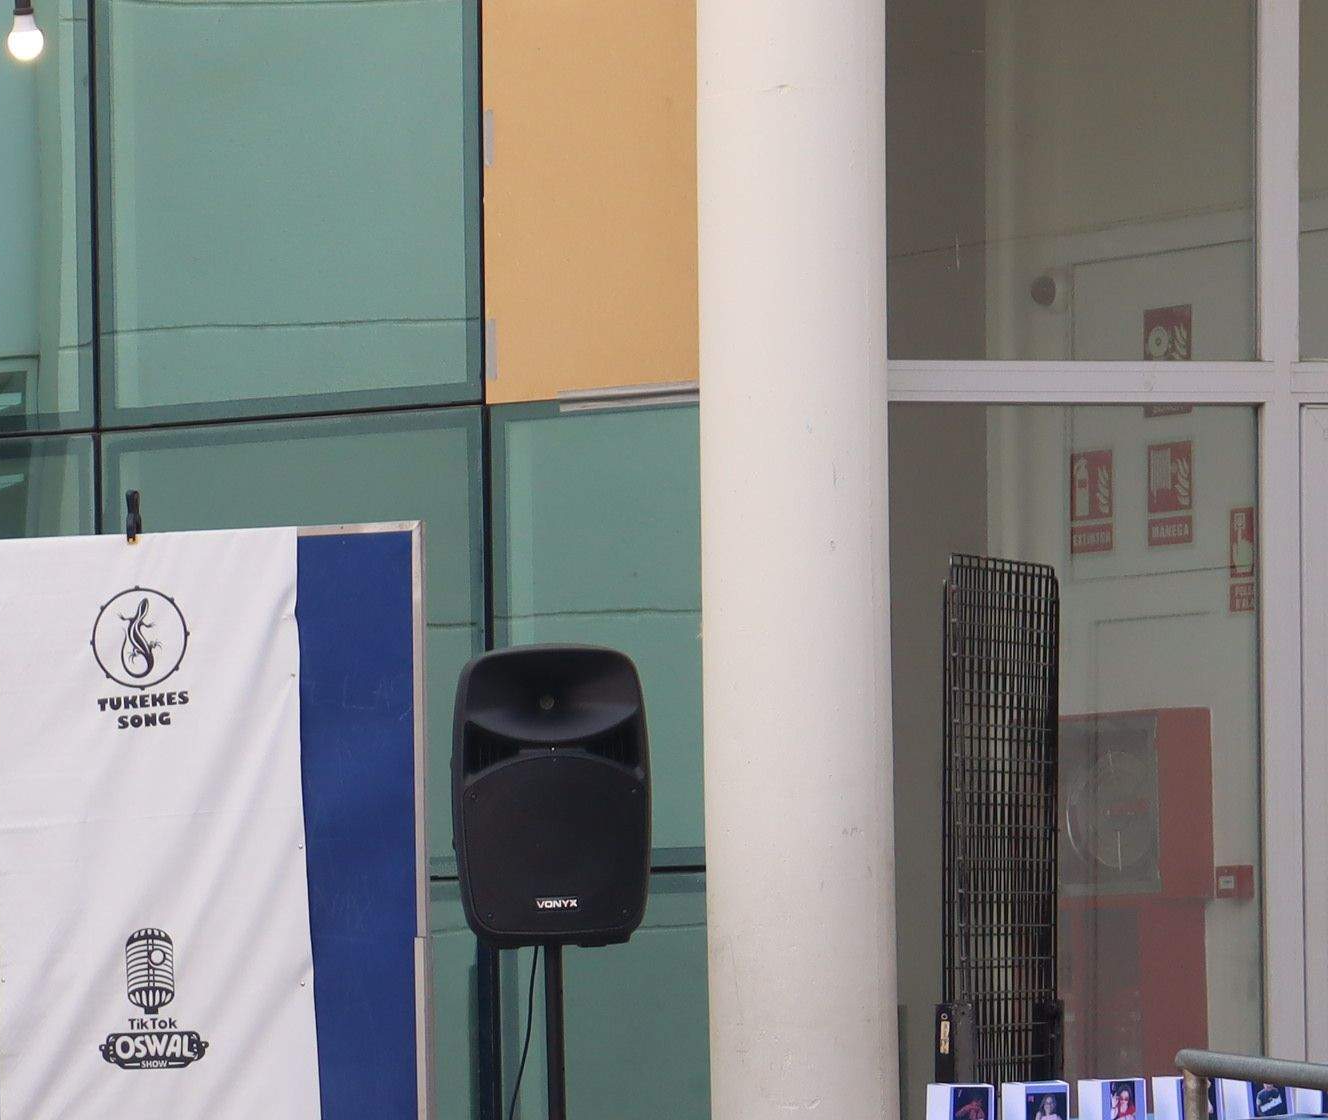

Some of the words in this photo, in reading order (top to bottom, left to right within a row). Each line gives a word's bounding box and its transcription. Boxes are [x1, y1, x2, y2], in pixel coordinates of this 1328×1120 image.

[97, 690, 190, 712] TUKEKES
[117, 711, 171, 730] SONG
[536, 899, 578, 909] VONYX
[128, 1017, 178, 1031] TikTok
[115, 1033, 196, 1060] OSWAL
[141, 1060, 168, 1068] SHOW
